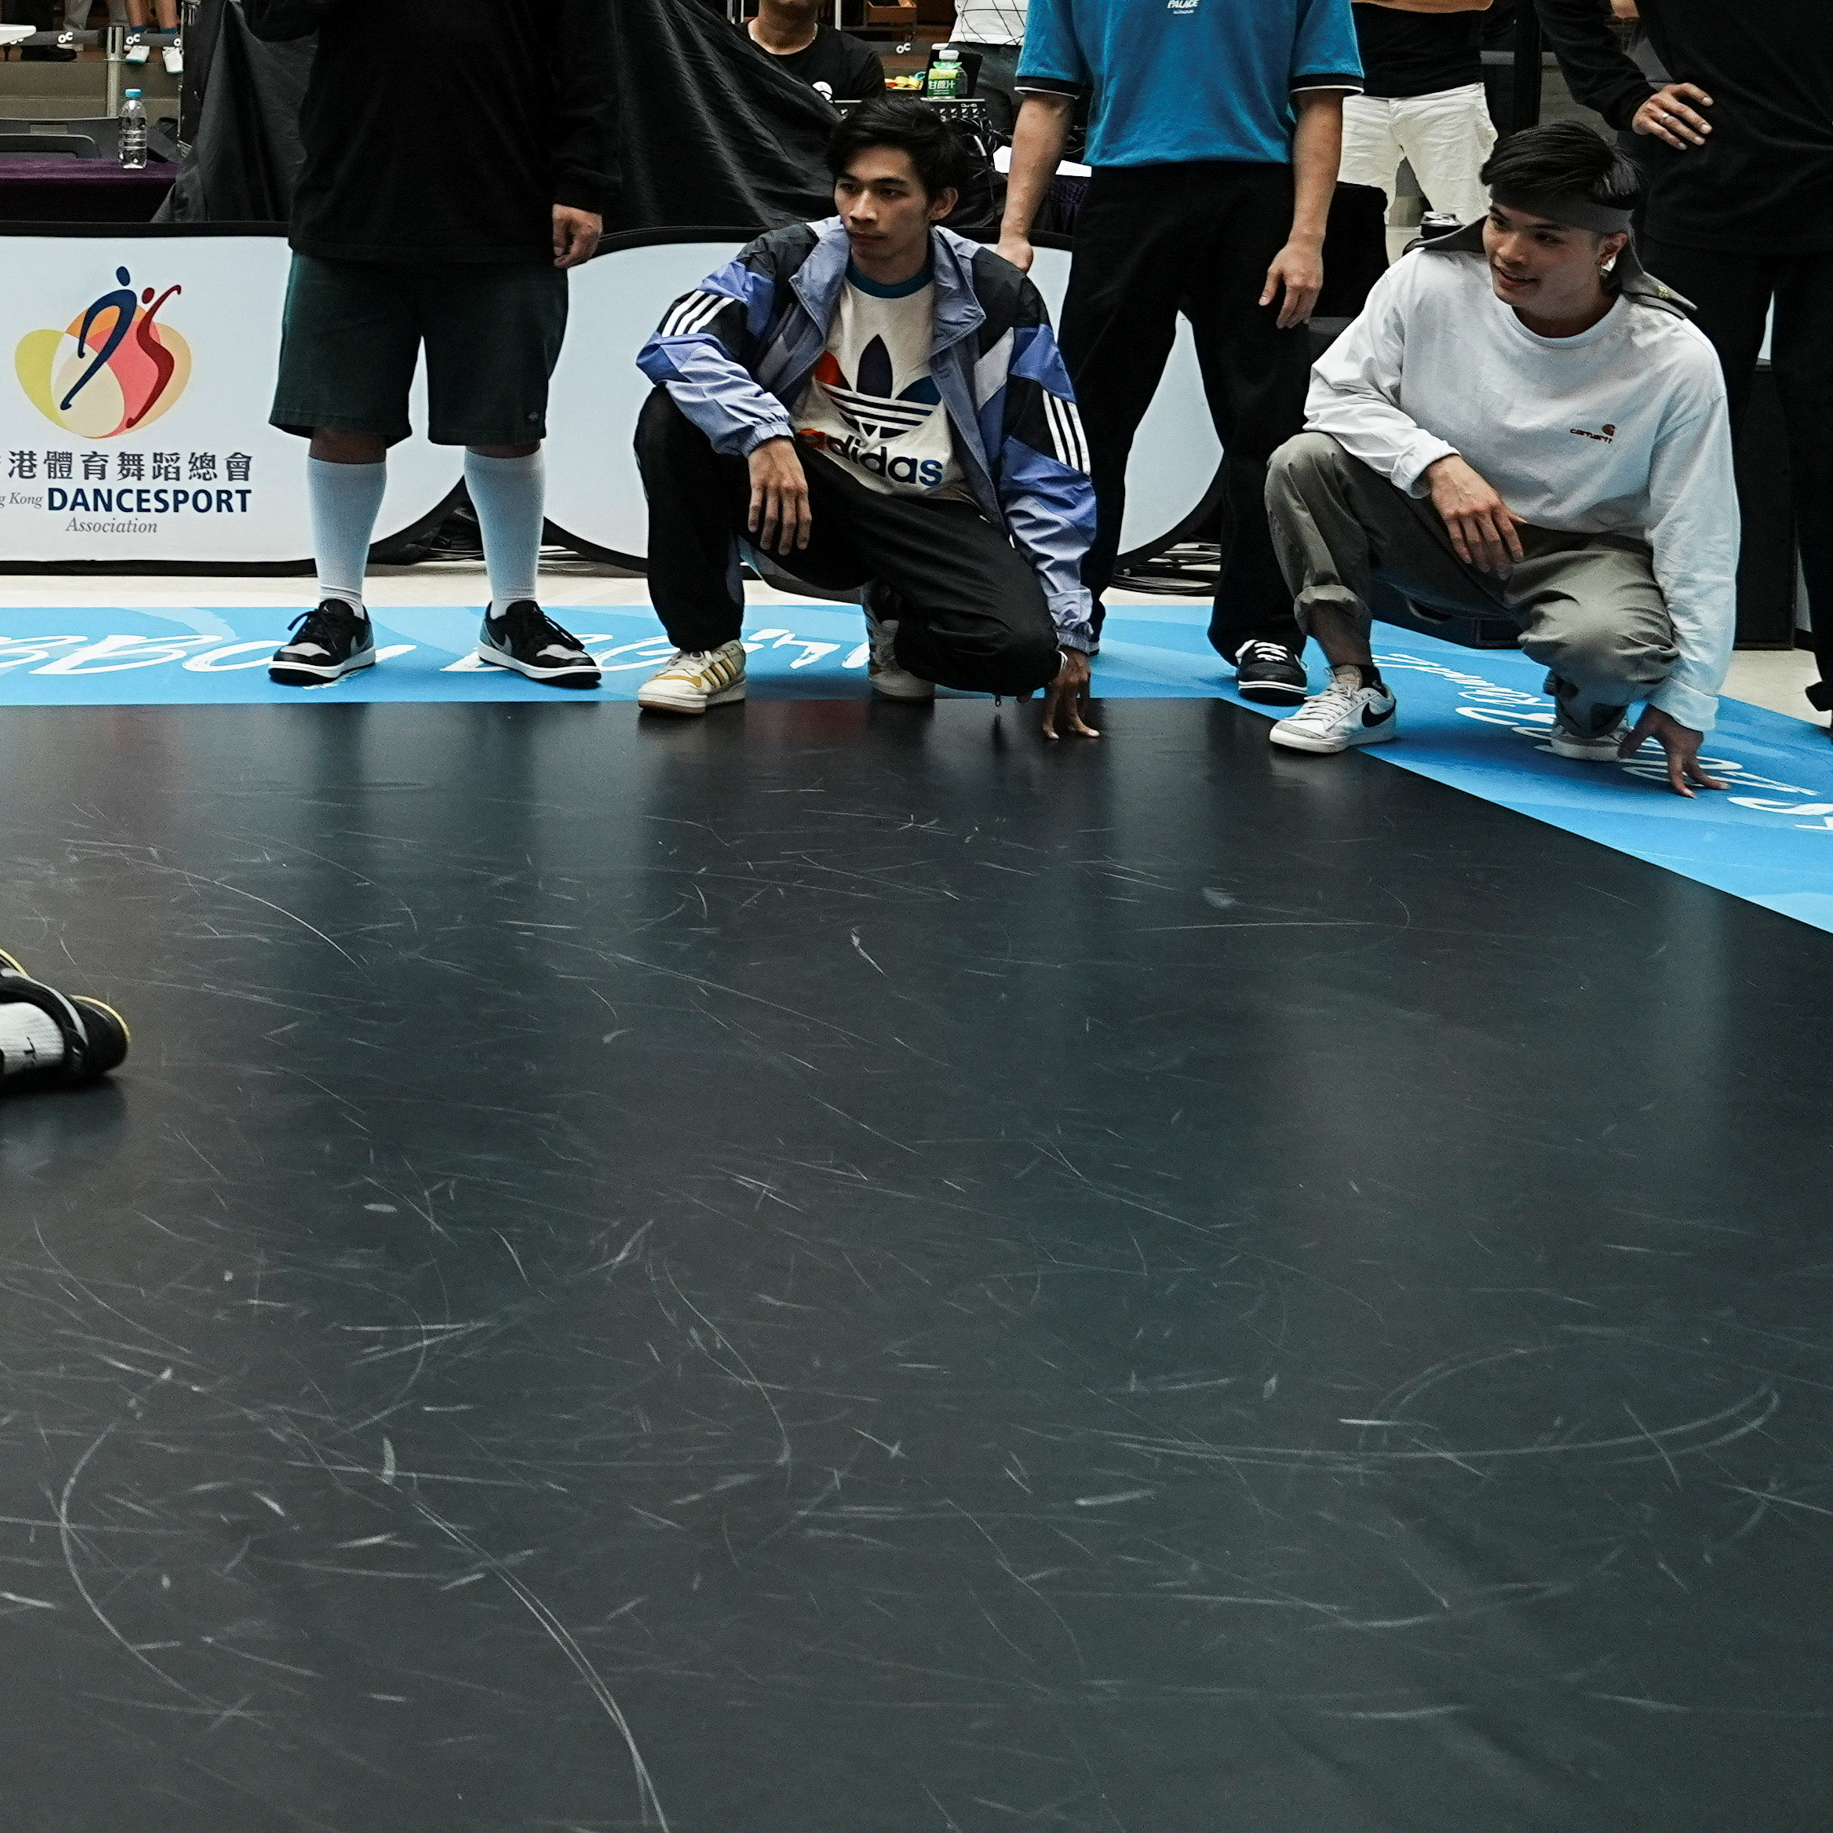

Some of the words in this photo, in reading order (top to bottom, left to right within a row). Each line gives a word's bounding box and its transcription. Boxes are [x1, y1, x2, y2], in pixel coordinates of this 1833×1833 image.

[1167, 0, 1200, 9] PALACE
[808, 428, 943, 488] adidas
[8, 491, 44, 511] Kong
[47, 487, 253, 514] DANCESPORT
[65, 516, 158, 534] Association
